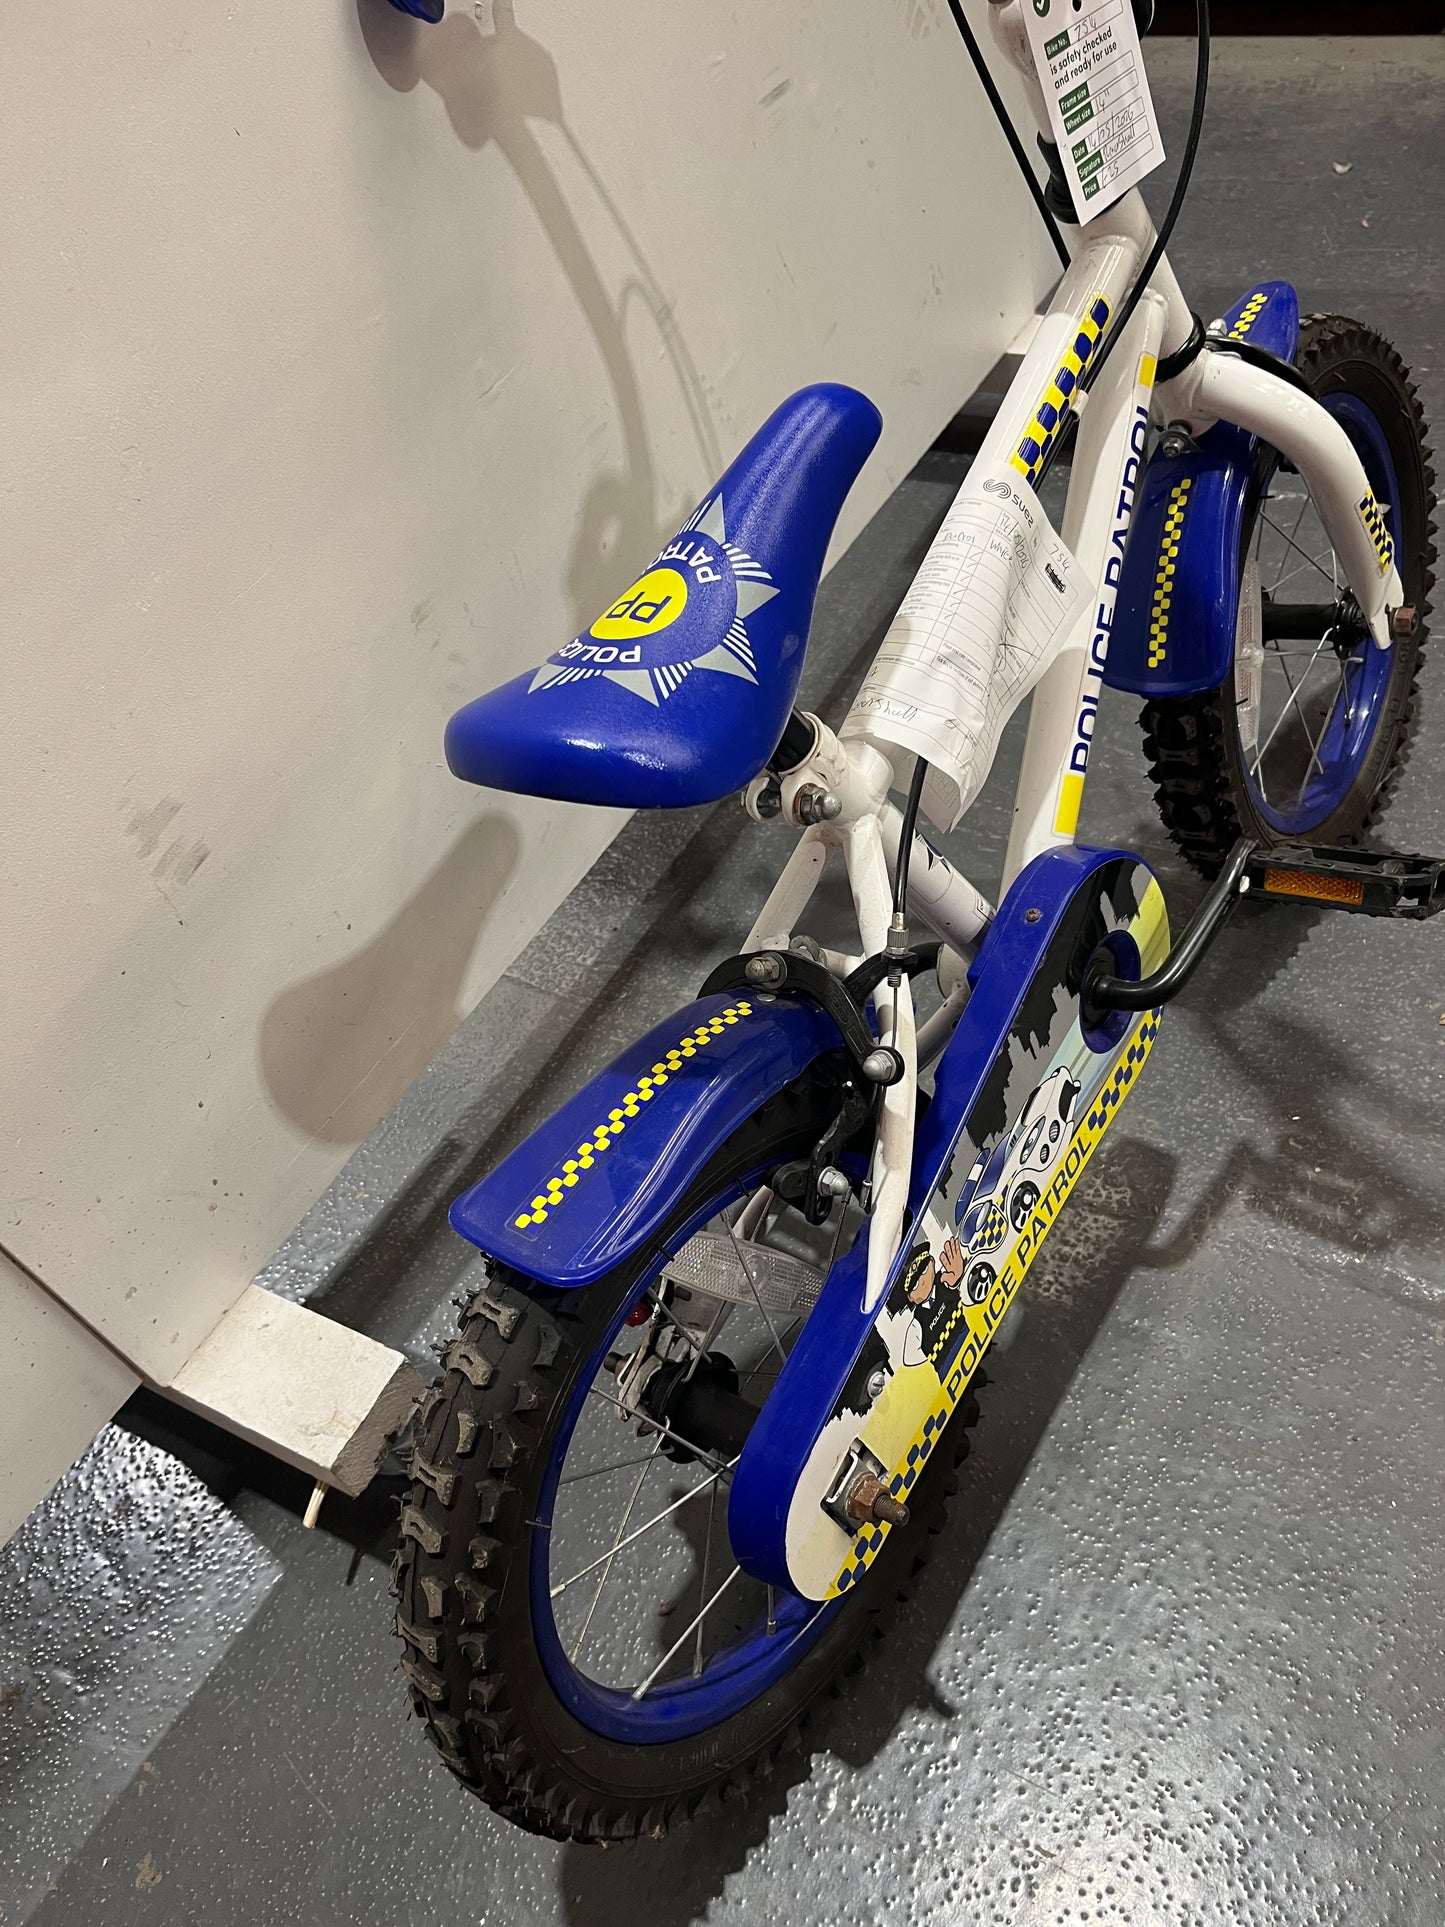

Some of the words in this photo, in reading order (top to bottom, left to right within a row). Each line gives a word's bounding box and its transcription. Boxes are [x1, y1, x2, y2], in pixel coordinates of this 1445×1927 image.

[1046, 42, 1058, 55] Bike
[1050, 64, 1058, 76] is
[1059, 49, 1081, 71] safety
[1083, 26, 1112, 54] checked
[1054, 70, 1070, 89] and
[1070, 57, 1092, 78] ready
[1092, 51, 1103, 63] for
[1104, 42, 1117, 56] use
[1061, 96, 1077, 111] Frame
[1077, 89, 1087, 102] size
[1065, 116, 1081, 130] Wheel
[1081, 109, 1091, 121] size
[1074, 147, 1085, 158] Date
[1078, 158, 1101, 178] Signature
[1084, 183, 1097, 196] Price
[1012, 494, 1034, 528] suez
[641, 541, 722, 584] PATRO
[605, 592, 672, 624] PP
[946, 1266, 1018, 1403] POLICE
[1017, 1139, 1092, 1268] PATROL
[928, 1303, 947, 1330] POLICE
